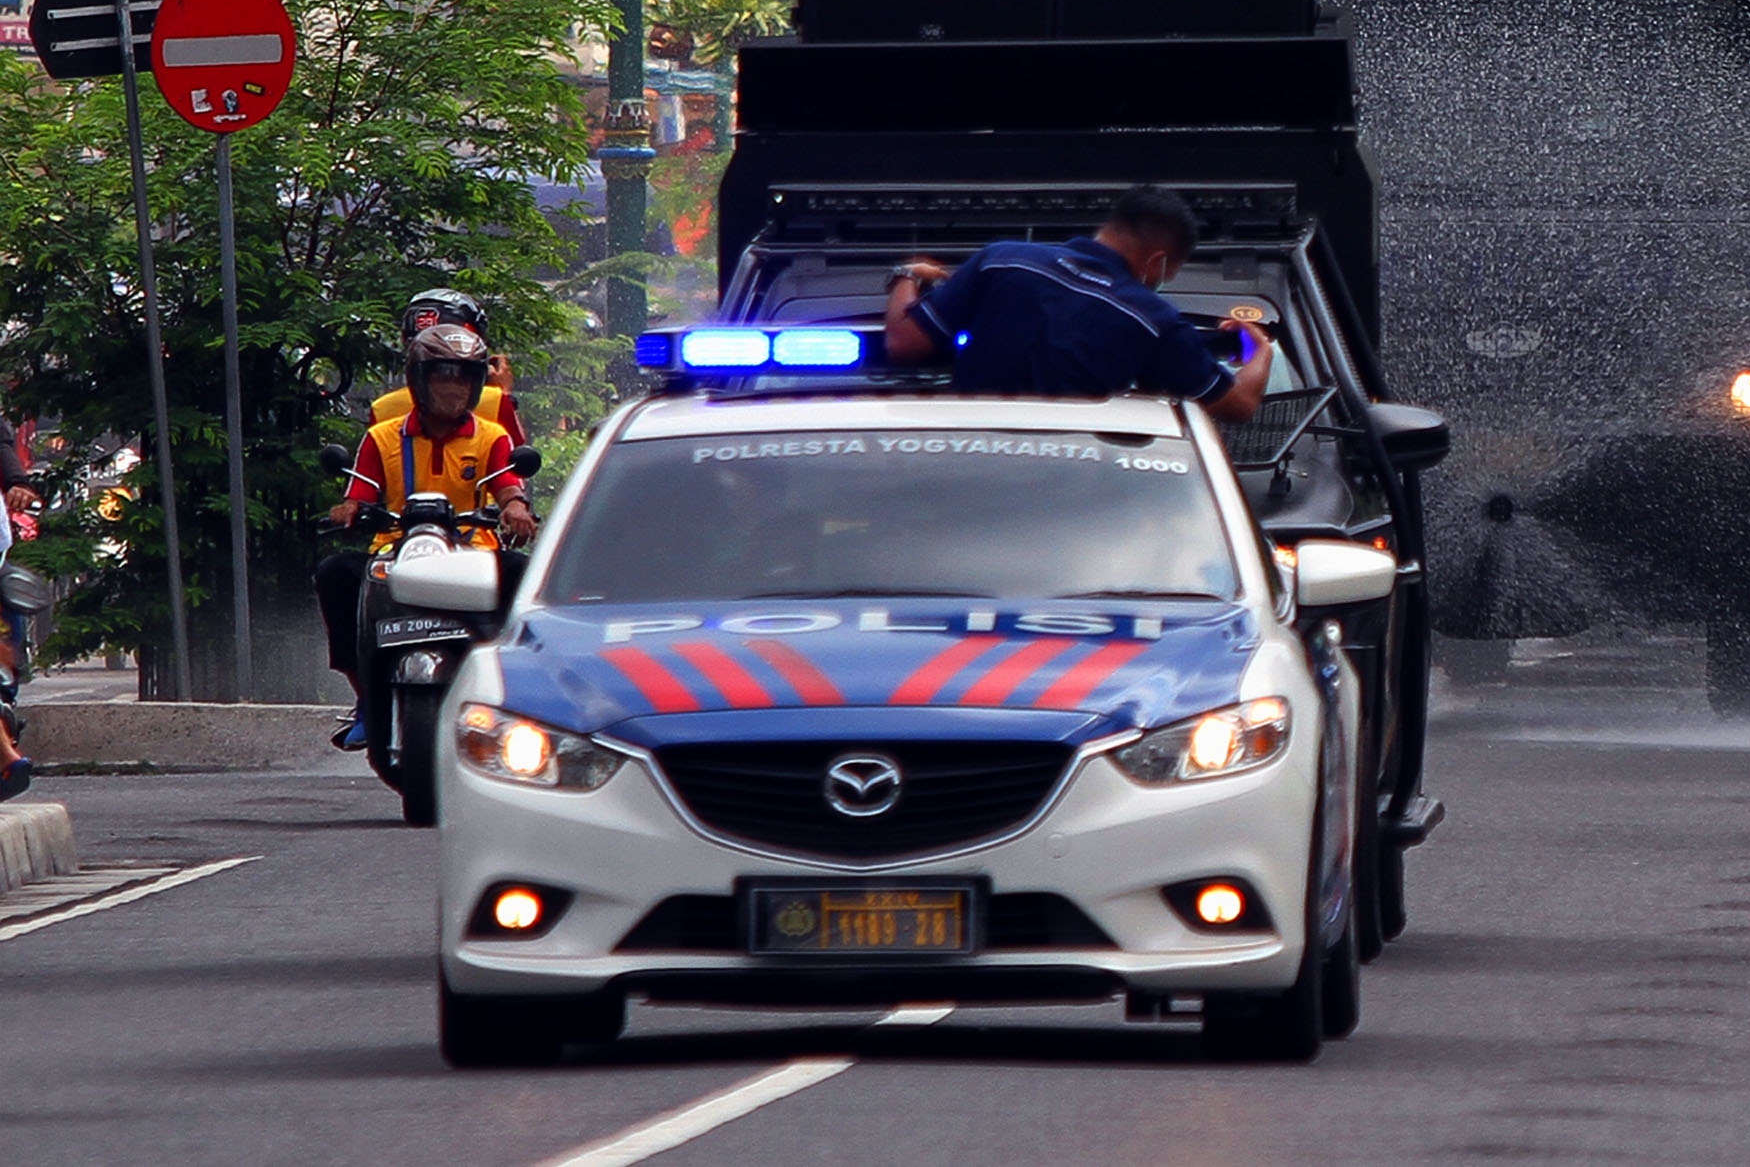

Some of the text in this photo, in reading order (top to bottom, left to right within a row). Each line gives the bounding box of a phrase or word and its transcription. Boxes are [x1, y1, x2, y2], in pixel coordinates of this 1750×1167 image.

[692, 437, 1102, 464] POLRESTA YOGYAKARTA
[1114, 456, 1190, 475] 1000
[383, 622, 401, 635] AB
[604, 612, 1162, 643] POLISI
